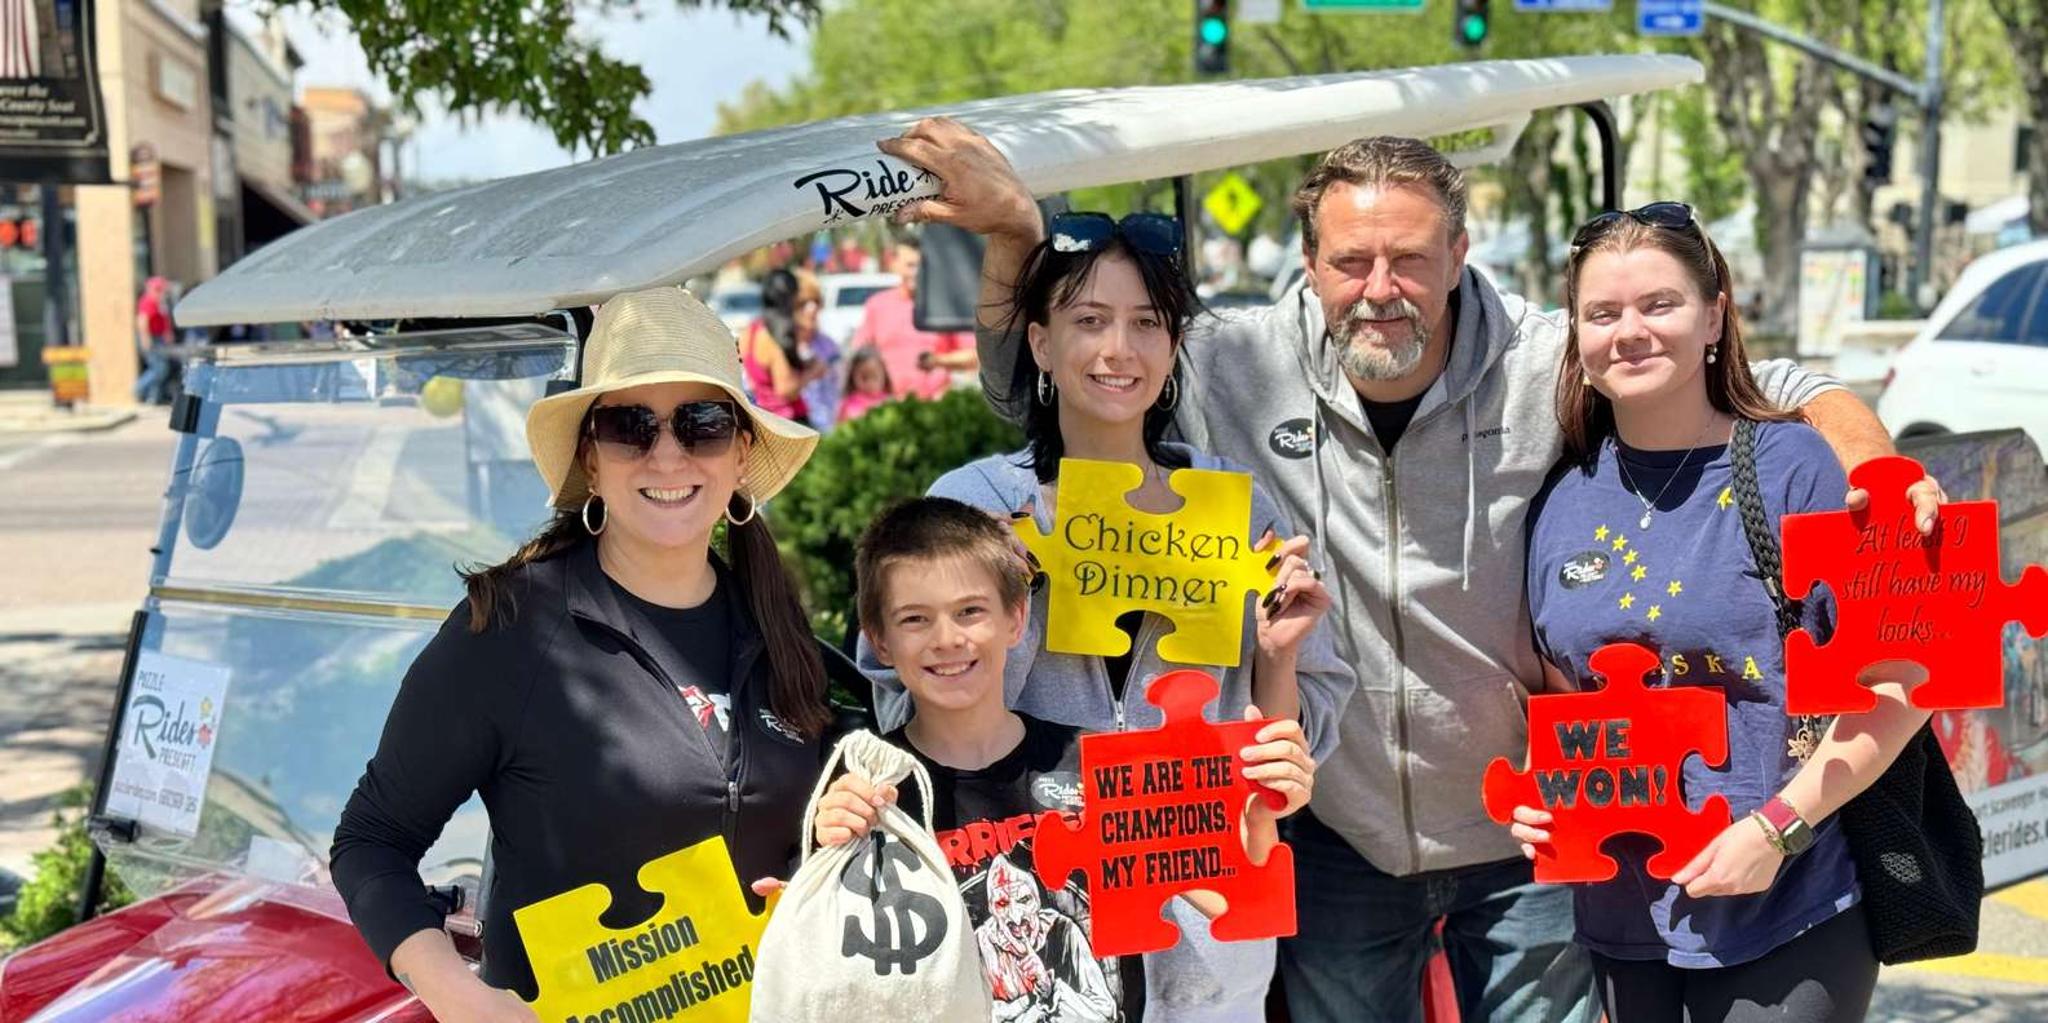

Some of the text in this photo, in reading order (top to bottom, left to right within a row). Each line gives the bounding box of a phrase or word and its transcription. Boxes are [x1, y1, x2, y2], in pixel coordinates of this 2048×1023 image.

[869, 194, 940, 216] PRES
[1065, 513, 1240, 562] Chicken
[1855, 520, 1888, 553] At
[1074, 560, 1228, 607] Dinner
[1841, 560, 1988, 609] still have my
[1553, 718, 1633, 761] WE
[1095, 755, 1233, 799] WE ARE THE
[1534, 765, 1668, 808] WON!
[1101, 801, 1232, 844] CHAMPIONS,
[1101, 846, 1236, 889] MY FRIEND...
[586, 914, 700, 985] Mission
[566, 944, 755, 1023] omplished
